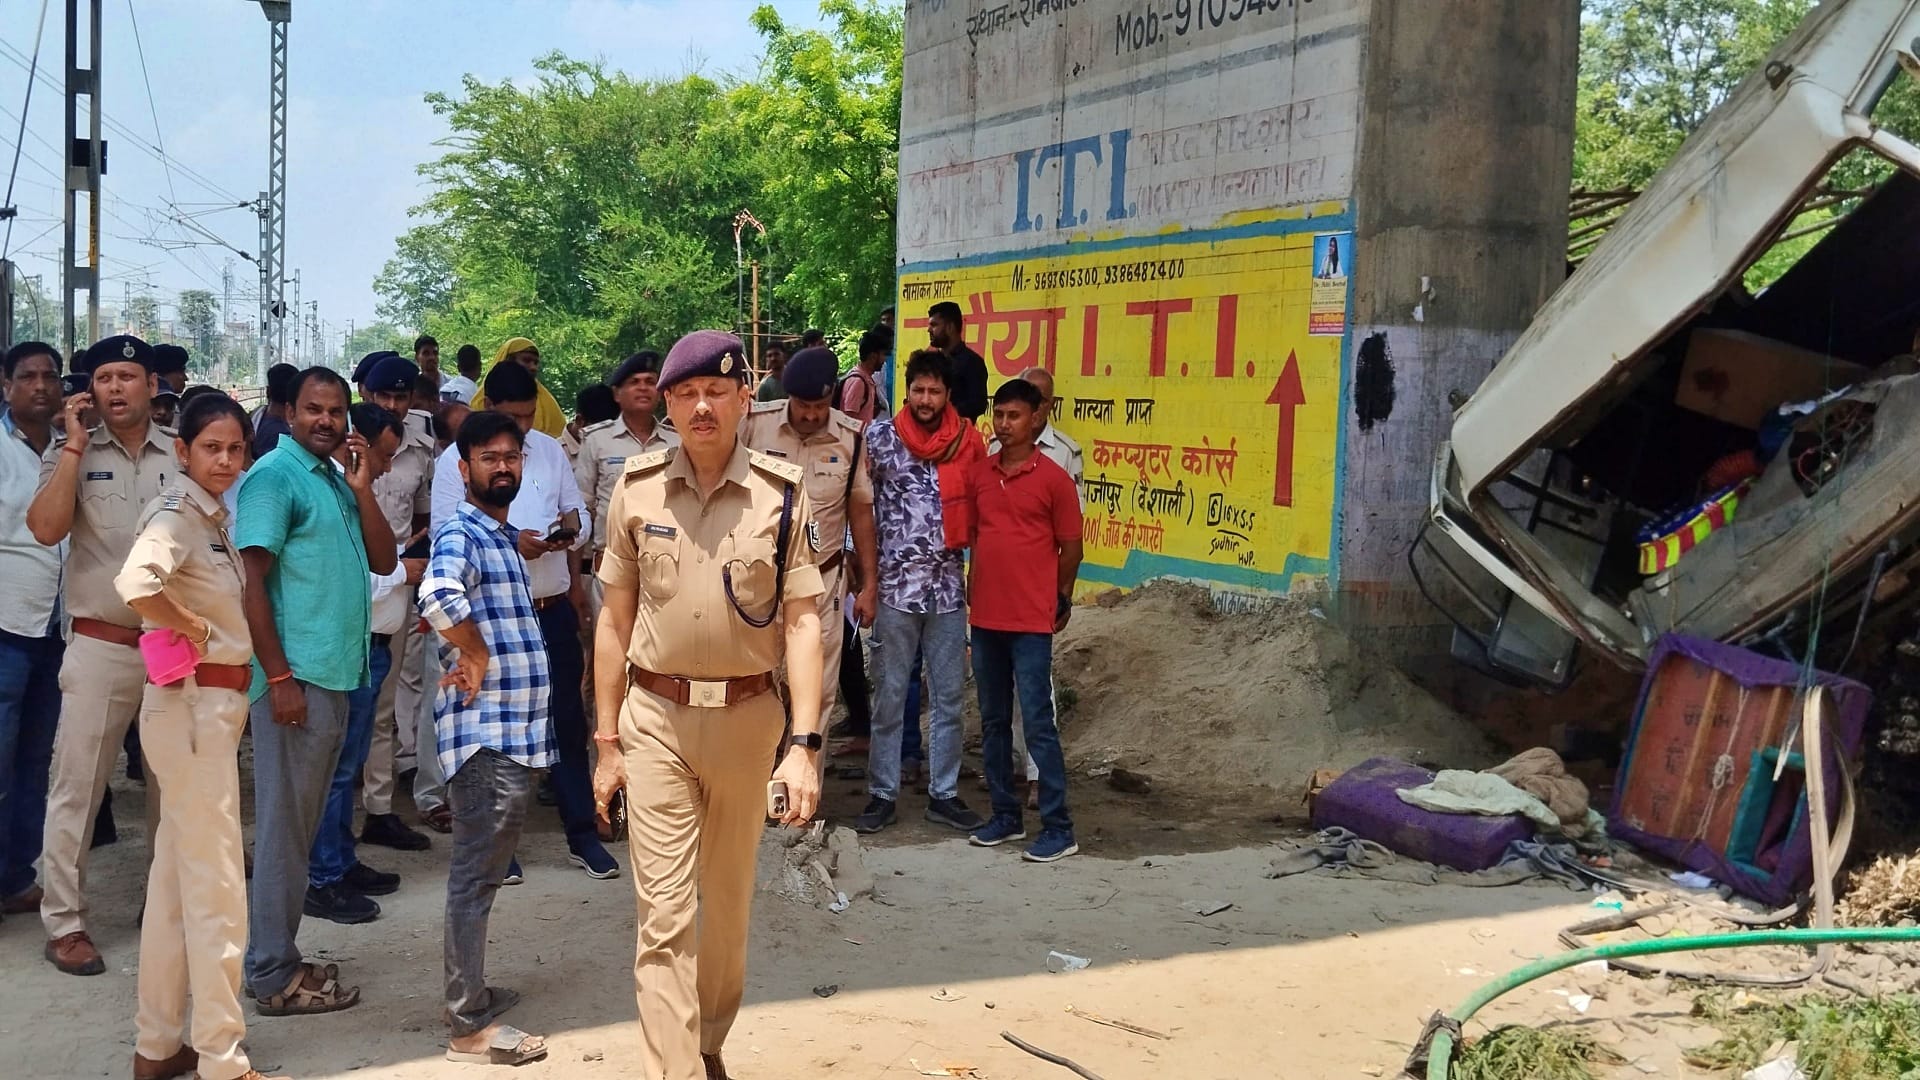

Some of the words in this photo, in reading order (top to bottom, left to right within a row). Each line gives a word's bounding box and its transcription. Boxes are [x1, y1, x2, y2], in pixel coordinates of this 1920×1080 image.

[1012, 128, 1136, 234] I.T.I.
[1080, 294, 1255, 378] I.T.I.
[1074, 397, 1115, 425] मान्यता
[1125, 398, 1155, 427] प्राप्त
[1093, 439, 1172, 484] कम्प्यूटर
[1181, 435, 1238, 487] कोर्स
[1084, 472, 1124, 515] ाजीपुर
[1122, 516, 1136, 549] की
